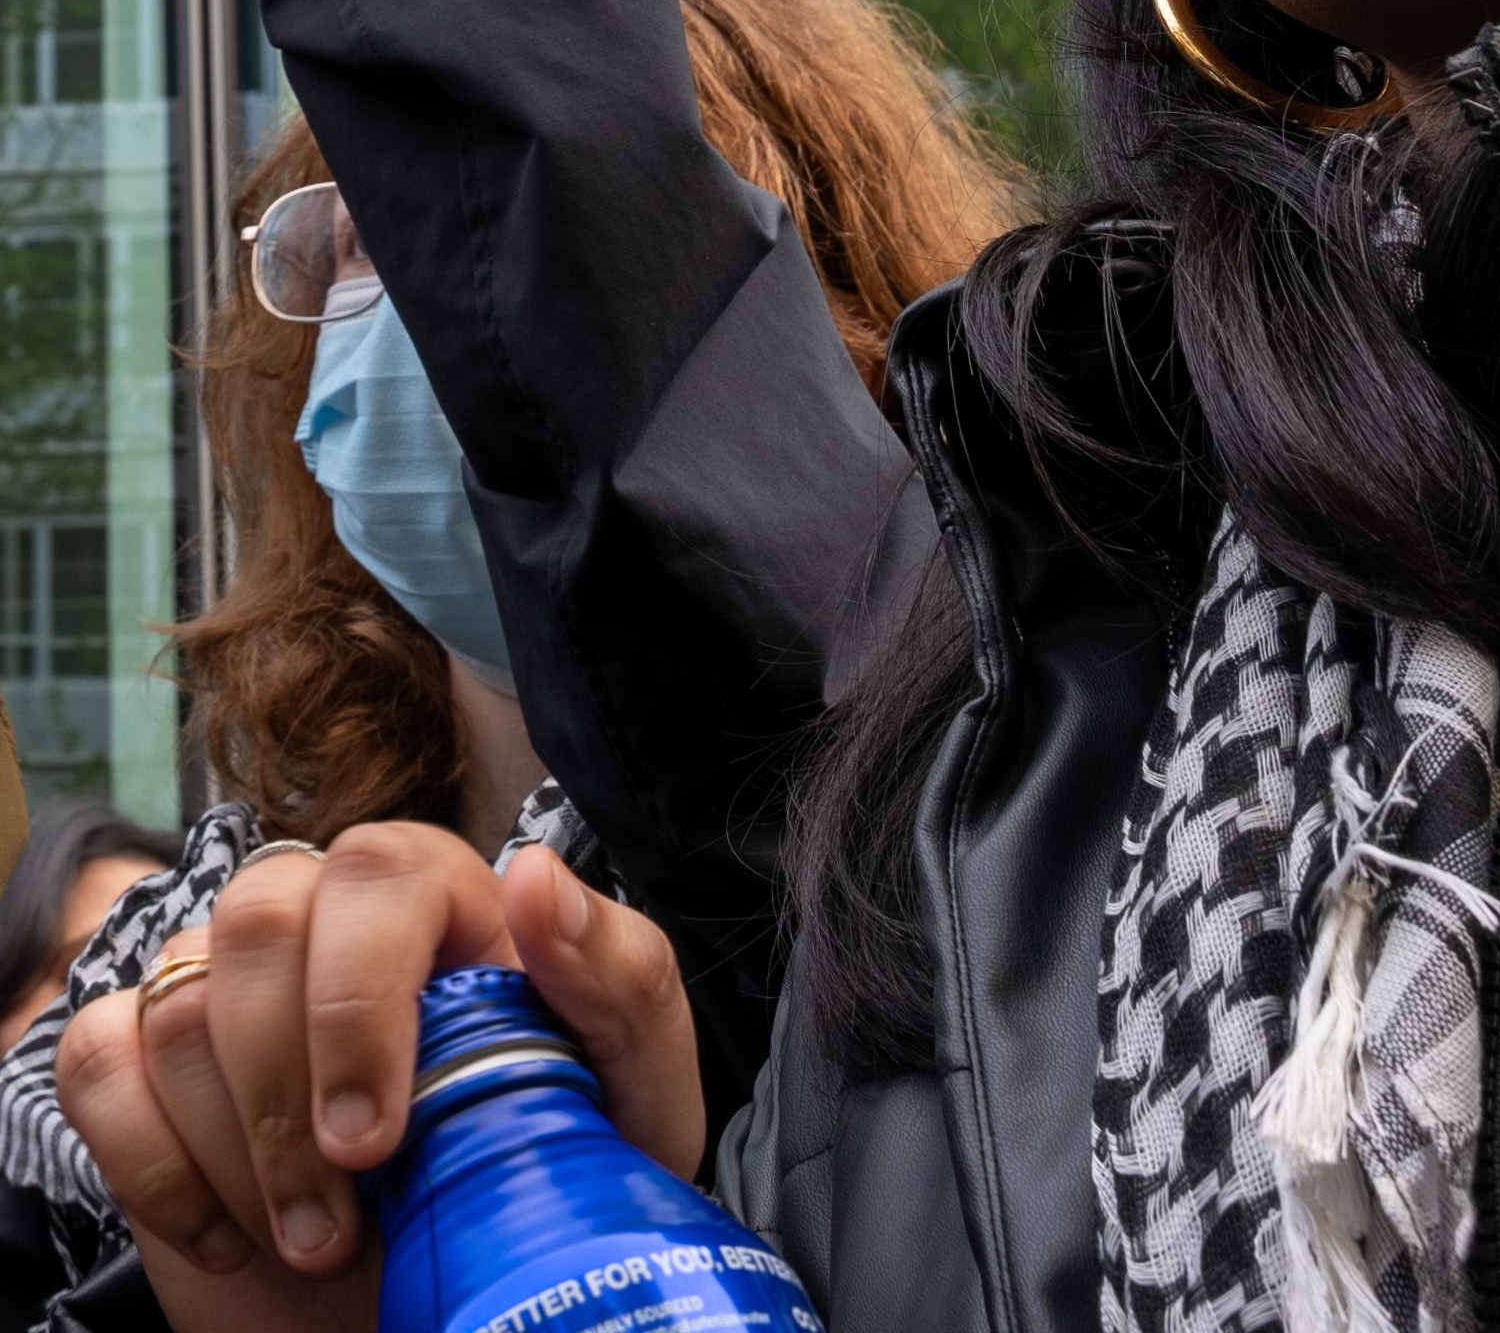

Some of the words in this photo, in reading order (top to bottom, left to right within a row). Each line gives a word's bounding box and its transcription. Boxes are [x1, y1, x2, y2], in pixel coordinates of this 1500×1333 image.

[472, 1278, 587, 1333] ETTER
[583, 1255, 655, 1300] FOR
[649, 1244, 725, 1277] YOU,
